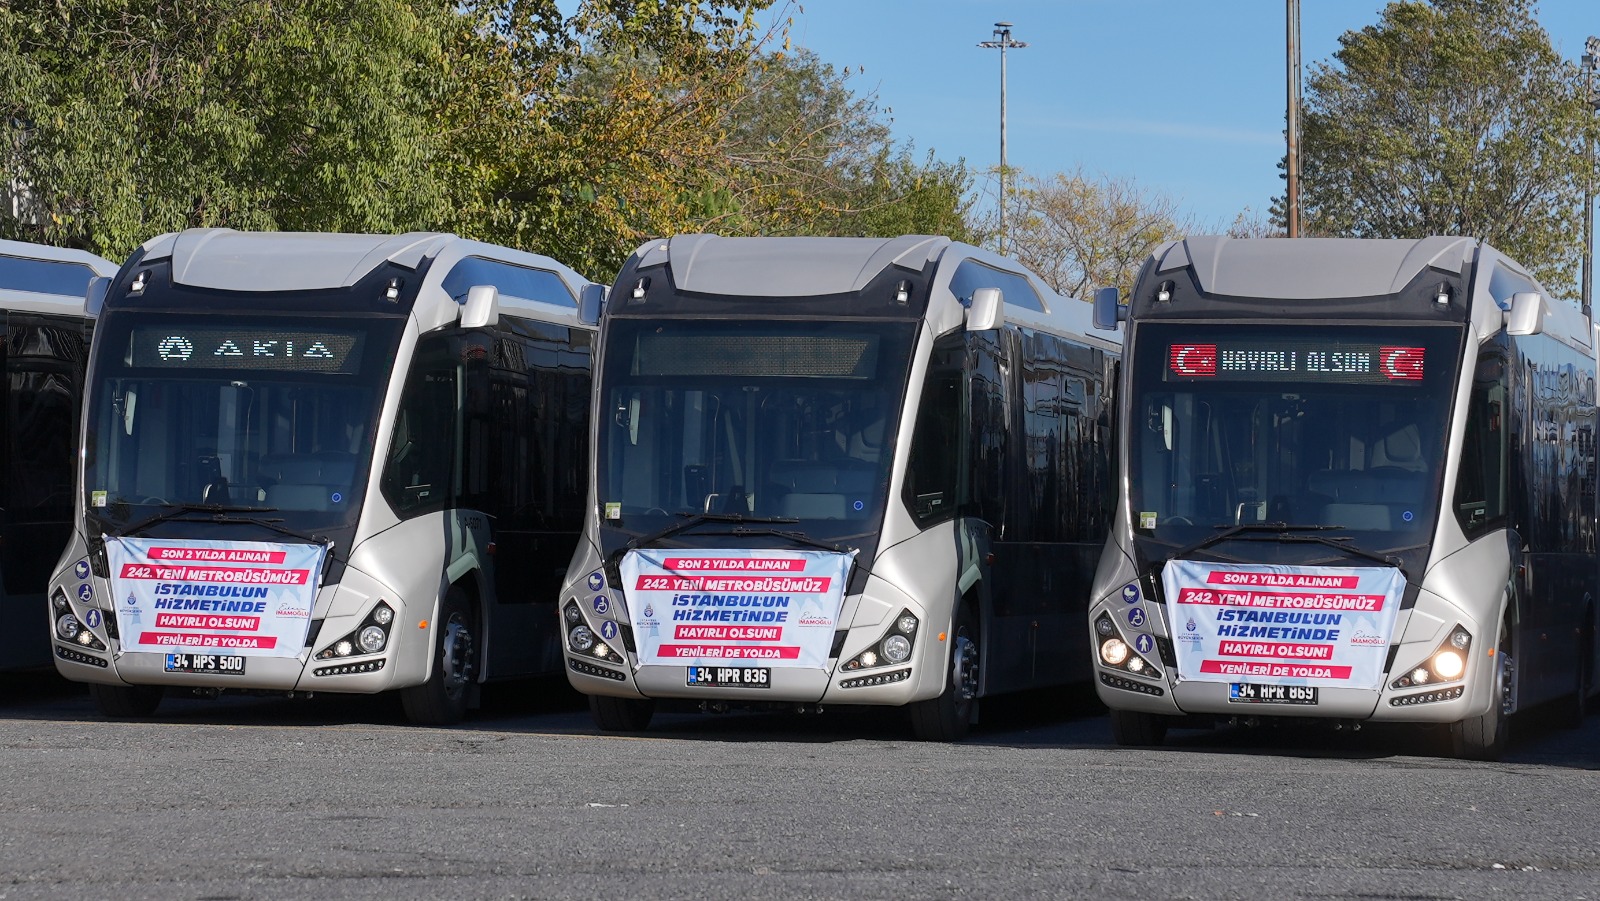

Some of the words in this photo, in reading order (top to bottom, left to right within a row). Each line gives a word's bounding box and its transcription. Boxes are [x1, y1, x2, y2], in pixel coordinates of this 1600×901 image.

[214, 340, 334, 358] AKIA
[1222, 350, 1296, 371] HAYIRLI
[1307, 352, 1370, 372] OLSUN
[162, 550, 182, 558] SON
[196, 551, 228, 560] YILDA
[229, 552, 270, 561] ALINAN
[677, 560, 702, 568] SON
[713, 560, 745, 569] YILDA
[746, 561, 790, 569] ALINAN
[127, 567, 152, 578] 242.
[156, 567, 186, 579] YENİ
[188, 569, 300, 583] METROBÜSÜMÜZ
[1224, 574, 1248, 583] SON
[1250, 575, 1257, 584] 2
[1260, 576, 1294, 586] YILDA
[1296, 577, 1342, 587] ALINAN
[644, 579, 670, 588] 242.
[674, 577, 703, 590] YENİ
[706, 578, 822, 591] METROBÜSÜMÜZ
[155, 598, 267, 612] HİZMETİNDE
[1186, 592, 1214, 603] 242.
[1218, 592, 1251, 605] YENİ
[1253, 595, 1376, 610] METROBÜSÜMÜZ
[160, 617, 206, 627] HAYIRLI
[209, 618, 254, 628] OLSUN!
[673, 609, 788, 622] HİZMETİNDE
[679, 628, 727, 638] HAYIRLI
[729, 628, 777, 639] OLSUN!
[1217, 625, 1340, 640] HİZMETİNDE
[156, 635, 202, 645] YENİLERİ
[204, 637, 219, 646] DE
[222, 638, 258, 647] YOLDA
[675, 646, 723, 657] YENİLERİ
[725, 648, 740, 657] DE
[742, 648, 780, 658] YOLDA
[1224, 644, 1274, 655] HAYIRLI
[1277, 646, 1327, 657] OLSUN!
[174, 654, 188, 668] 34
[193, 655, 215, 668] HPS
[220, 656, 242, 670] 500
[697, 668, 712, 682] 34
[718, 669, 740, 682] HPR
[744, 670, 767, 683] 836
[1220, 663, 1270, 675] YENİLERİ
[1273, 666, 1289, 676] DE
[1292, 667, 1331, 678] YOLDA
[1239, 684, 1254, 698] 34
[1260, 686, 1284, 698] HPR
